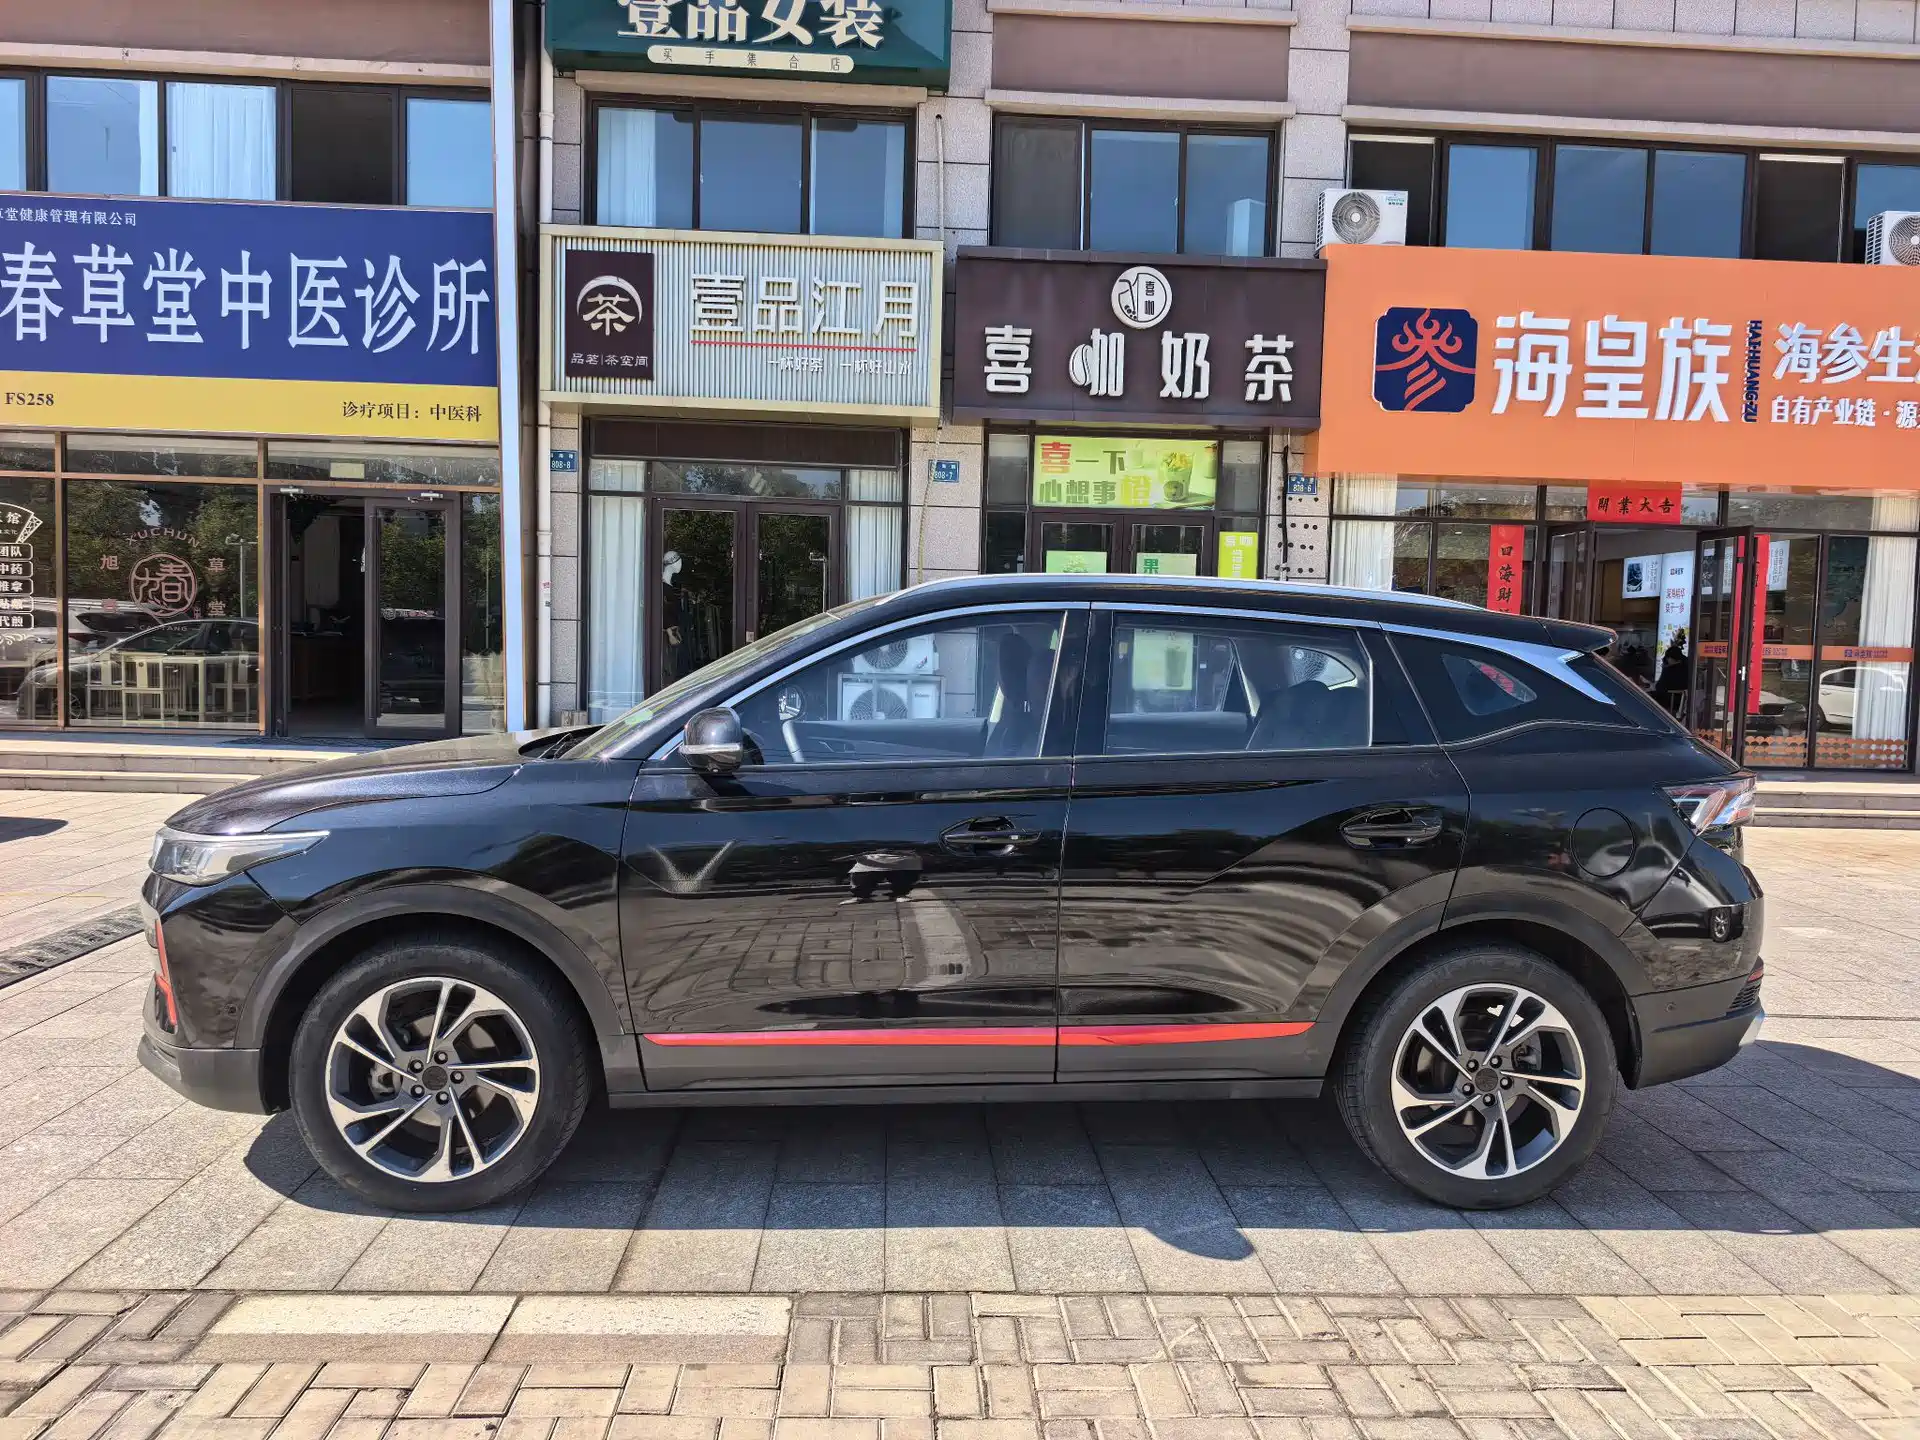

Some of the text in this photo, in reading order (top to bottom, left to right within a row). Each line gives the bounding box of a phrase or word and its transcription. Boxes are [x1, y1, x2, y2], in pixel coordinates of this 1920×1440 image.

[617, 0, 885, 48] 壹品女装
[663, 48, 840, 71] 买手集合店
[0, 207, 136, 226] 堂健康管理有限公司
[0, 241, 490, 354] 春草堂中医诊所
[583, 293, 636, 336] 茶
[691, 272, 919, 338] 壹品江月
[1491, 311, 1733, 423] 海皇族
[1772, 322, 1920, 384] 海参生
[4, 392, 54, 406] FS258
[1770, 396, 1920, 429] 自有产业链·源
[1041, 442, 1126, 474] 喜一下
[0, 511, 21, 524] 馆
[127, 527, 200, 548] XUCHUN
[1496, 545, 1515, 613] 四海財
